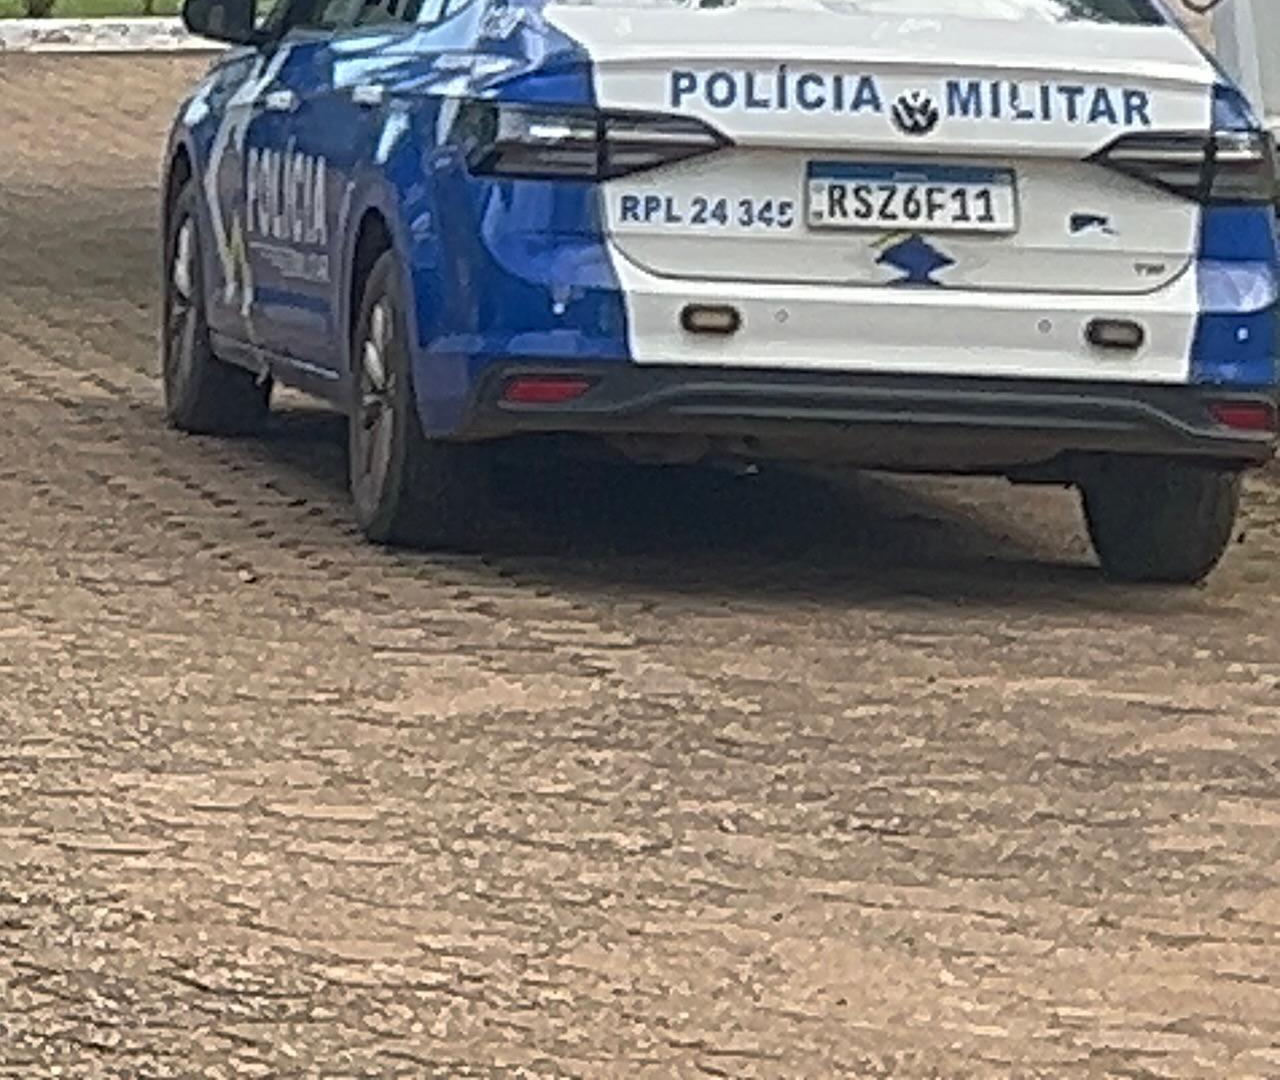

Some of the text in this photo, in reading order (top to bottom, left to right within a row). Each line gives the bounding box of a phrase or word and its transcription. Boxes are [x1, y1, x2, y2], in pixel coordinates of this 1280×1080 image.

[669, 66, 1153, 127] POLÍCIA MILITAR
[620, 194, 683, 222] RPL
[689, 197, 728, 226] 24
[826, 183, 996, 224] RSZ6F11
